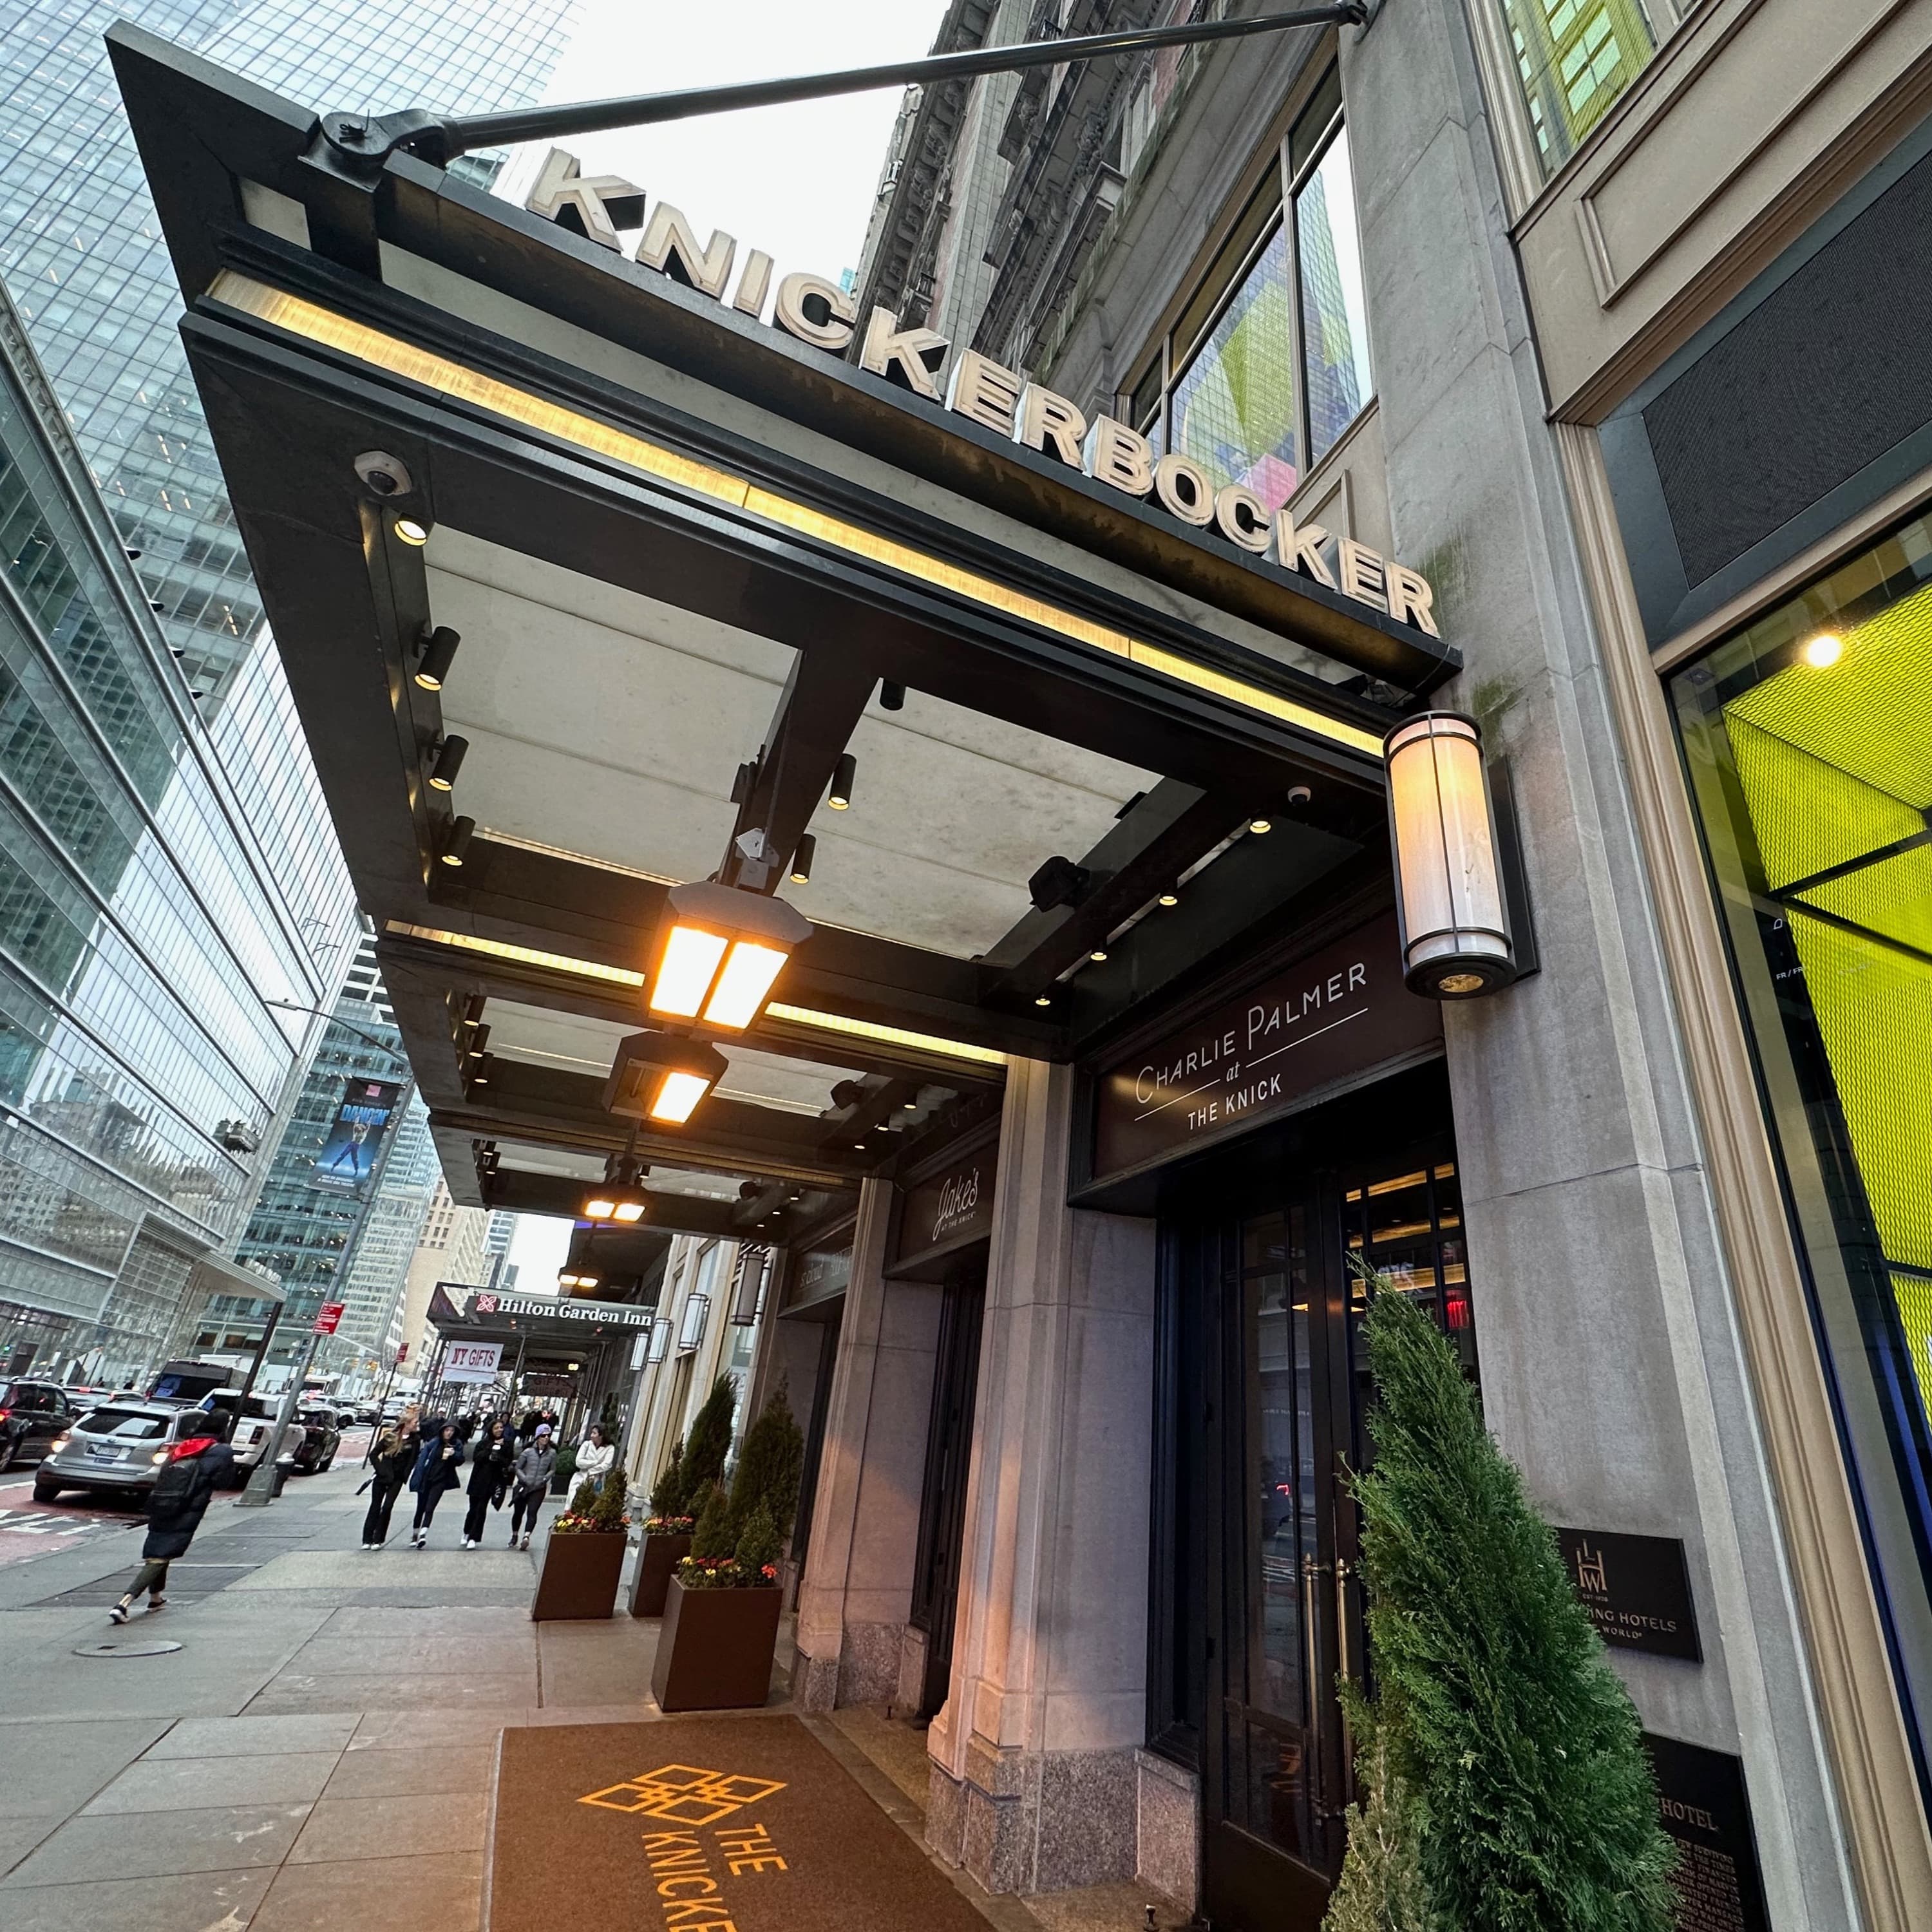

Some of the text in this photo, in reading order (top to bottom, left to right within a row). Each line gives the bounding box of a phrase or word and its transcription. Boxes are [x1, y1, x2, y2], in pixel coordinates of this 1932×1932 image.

[526, 146, 1441, 639] KNICKERBOCKER
[1136, 963, 1367, 1104] CHARLIE PALMER
[1226, 1061, 1240, 1082] at
[1188, 1074, 1282, 1130] THE KNICK
[933, 1168, 979, 1241] Jake's
[497, 1297, 652, 1326] Hilton Garden Inn
[451, 1347, 495, 1367] NY GIFTS
[1619, 1612, 1677, 1633] HOTELS
[1661, 1797, 1719, 1832] HOTEL
[715, 1824, 788, 1875] THE
